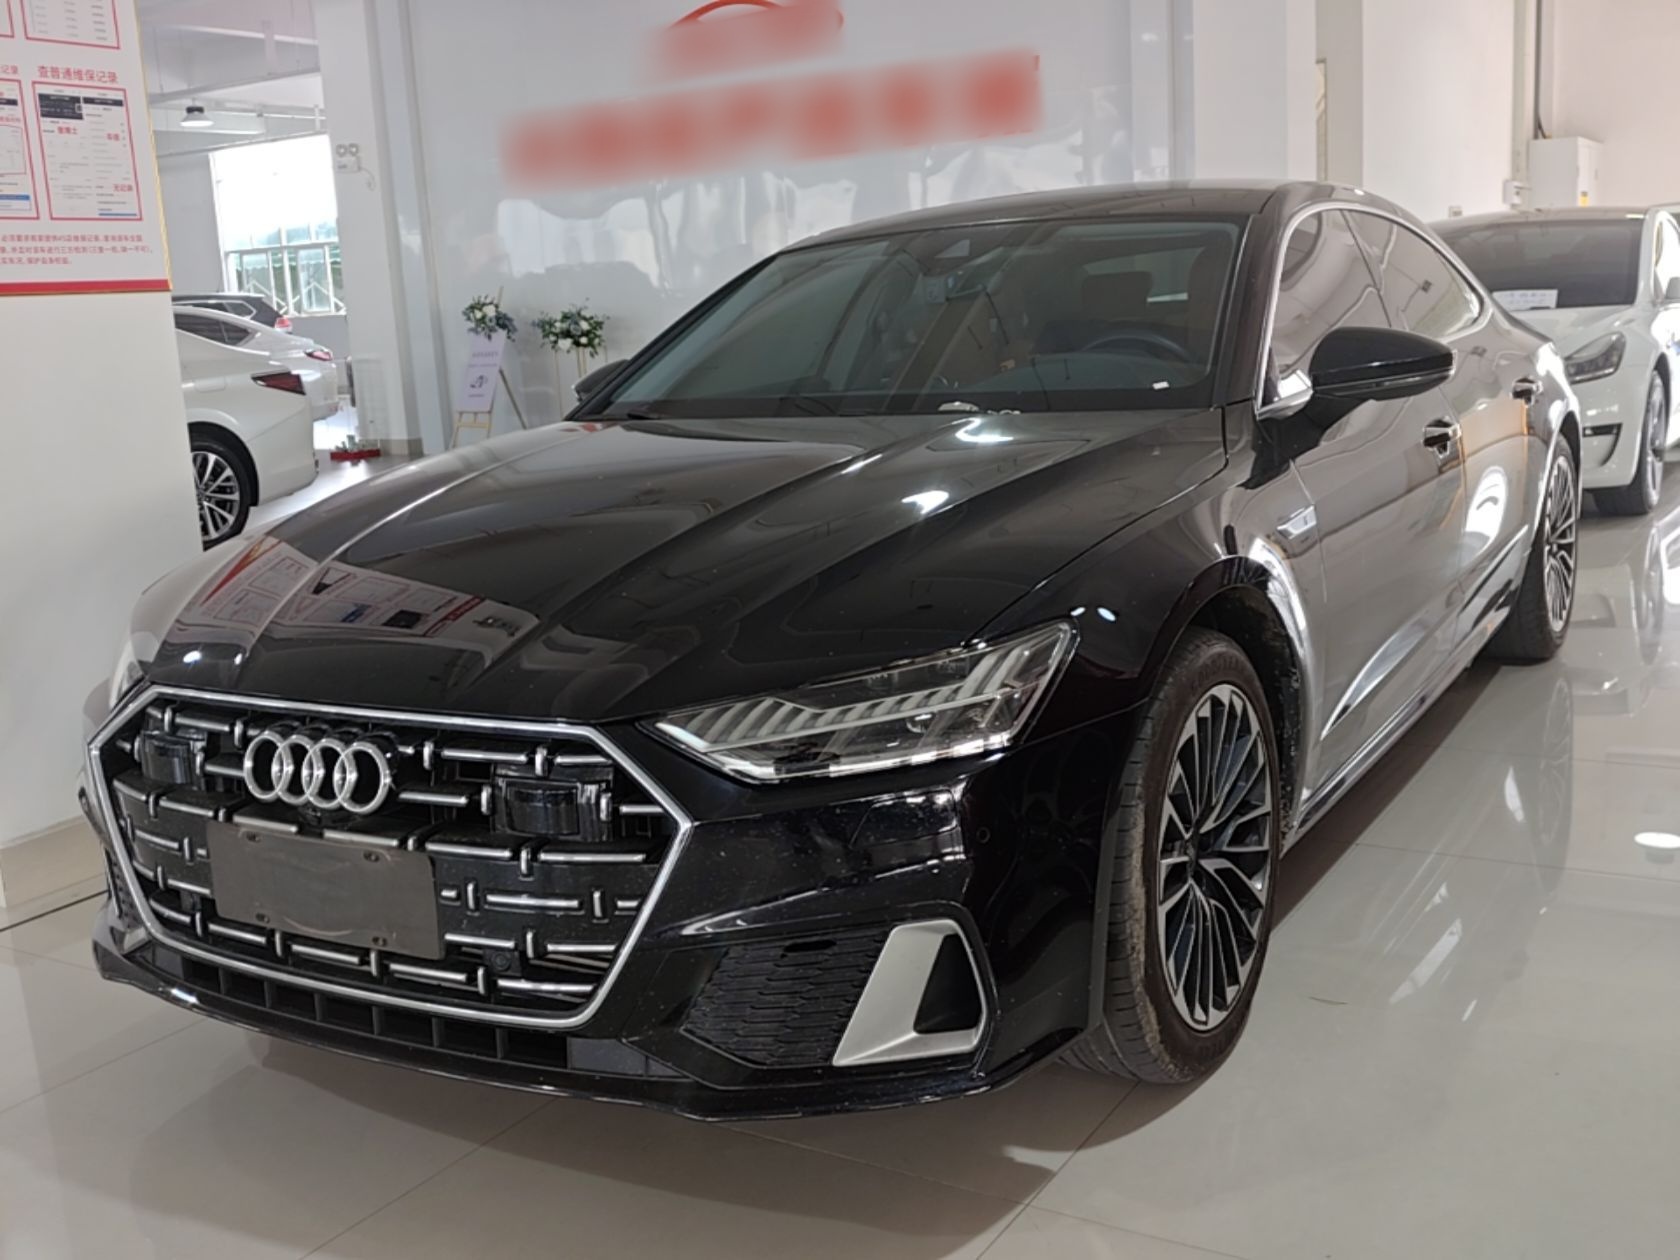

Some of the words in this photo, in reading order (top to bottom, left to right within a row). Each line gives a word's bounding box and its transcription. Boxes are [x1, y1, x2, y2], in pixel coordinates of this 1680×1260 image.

[37, 65, 118, 83] 查普通维保记录
